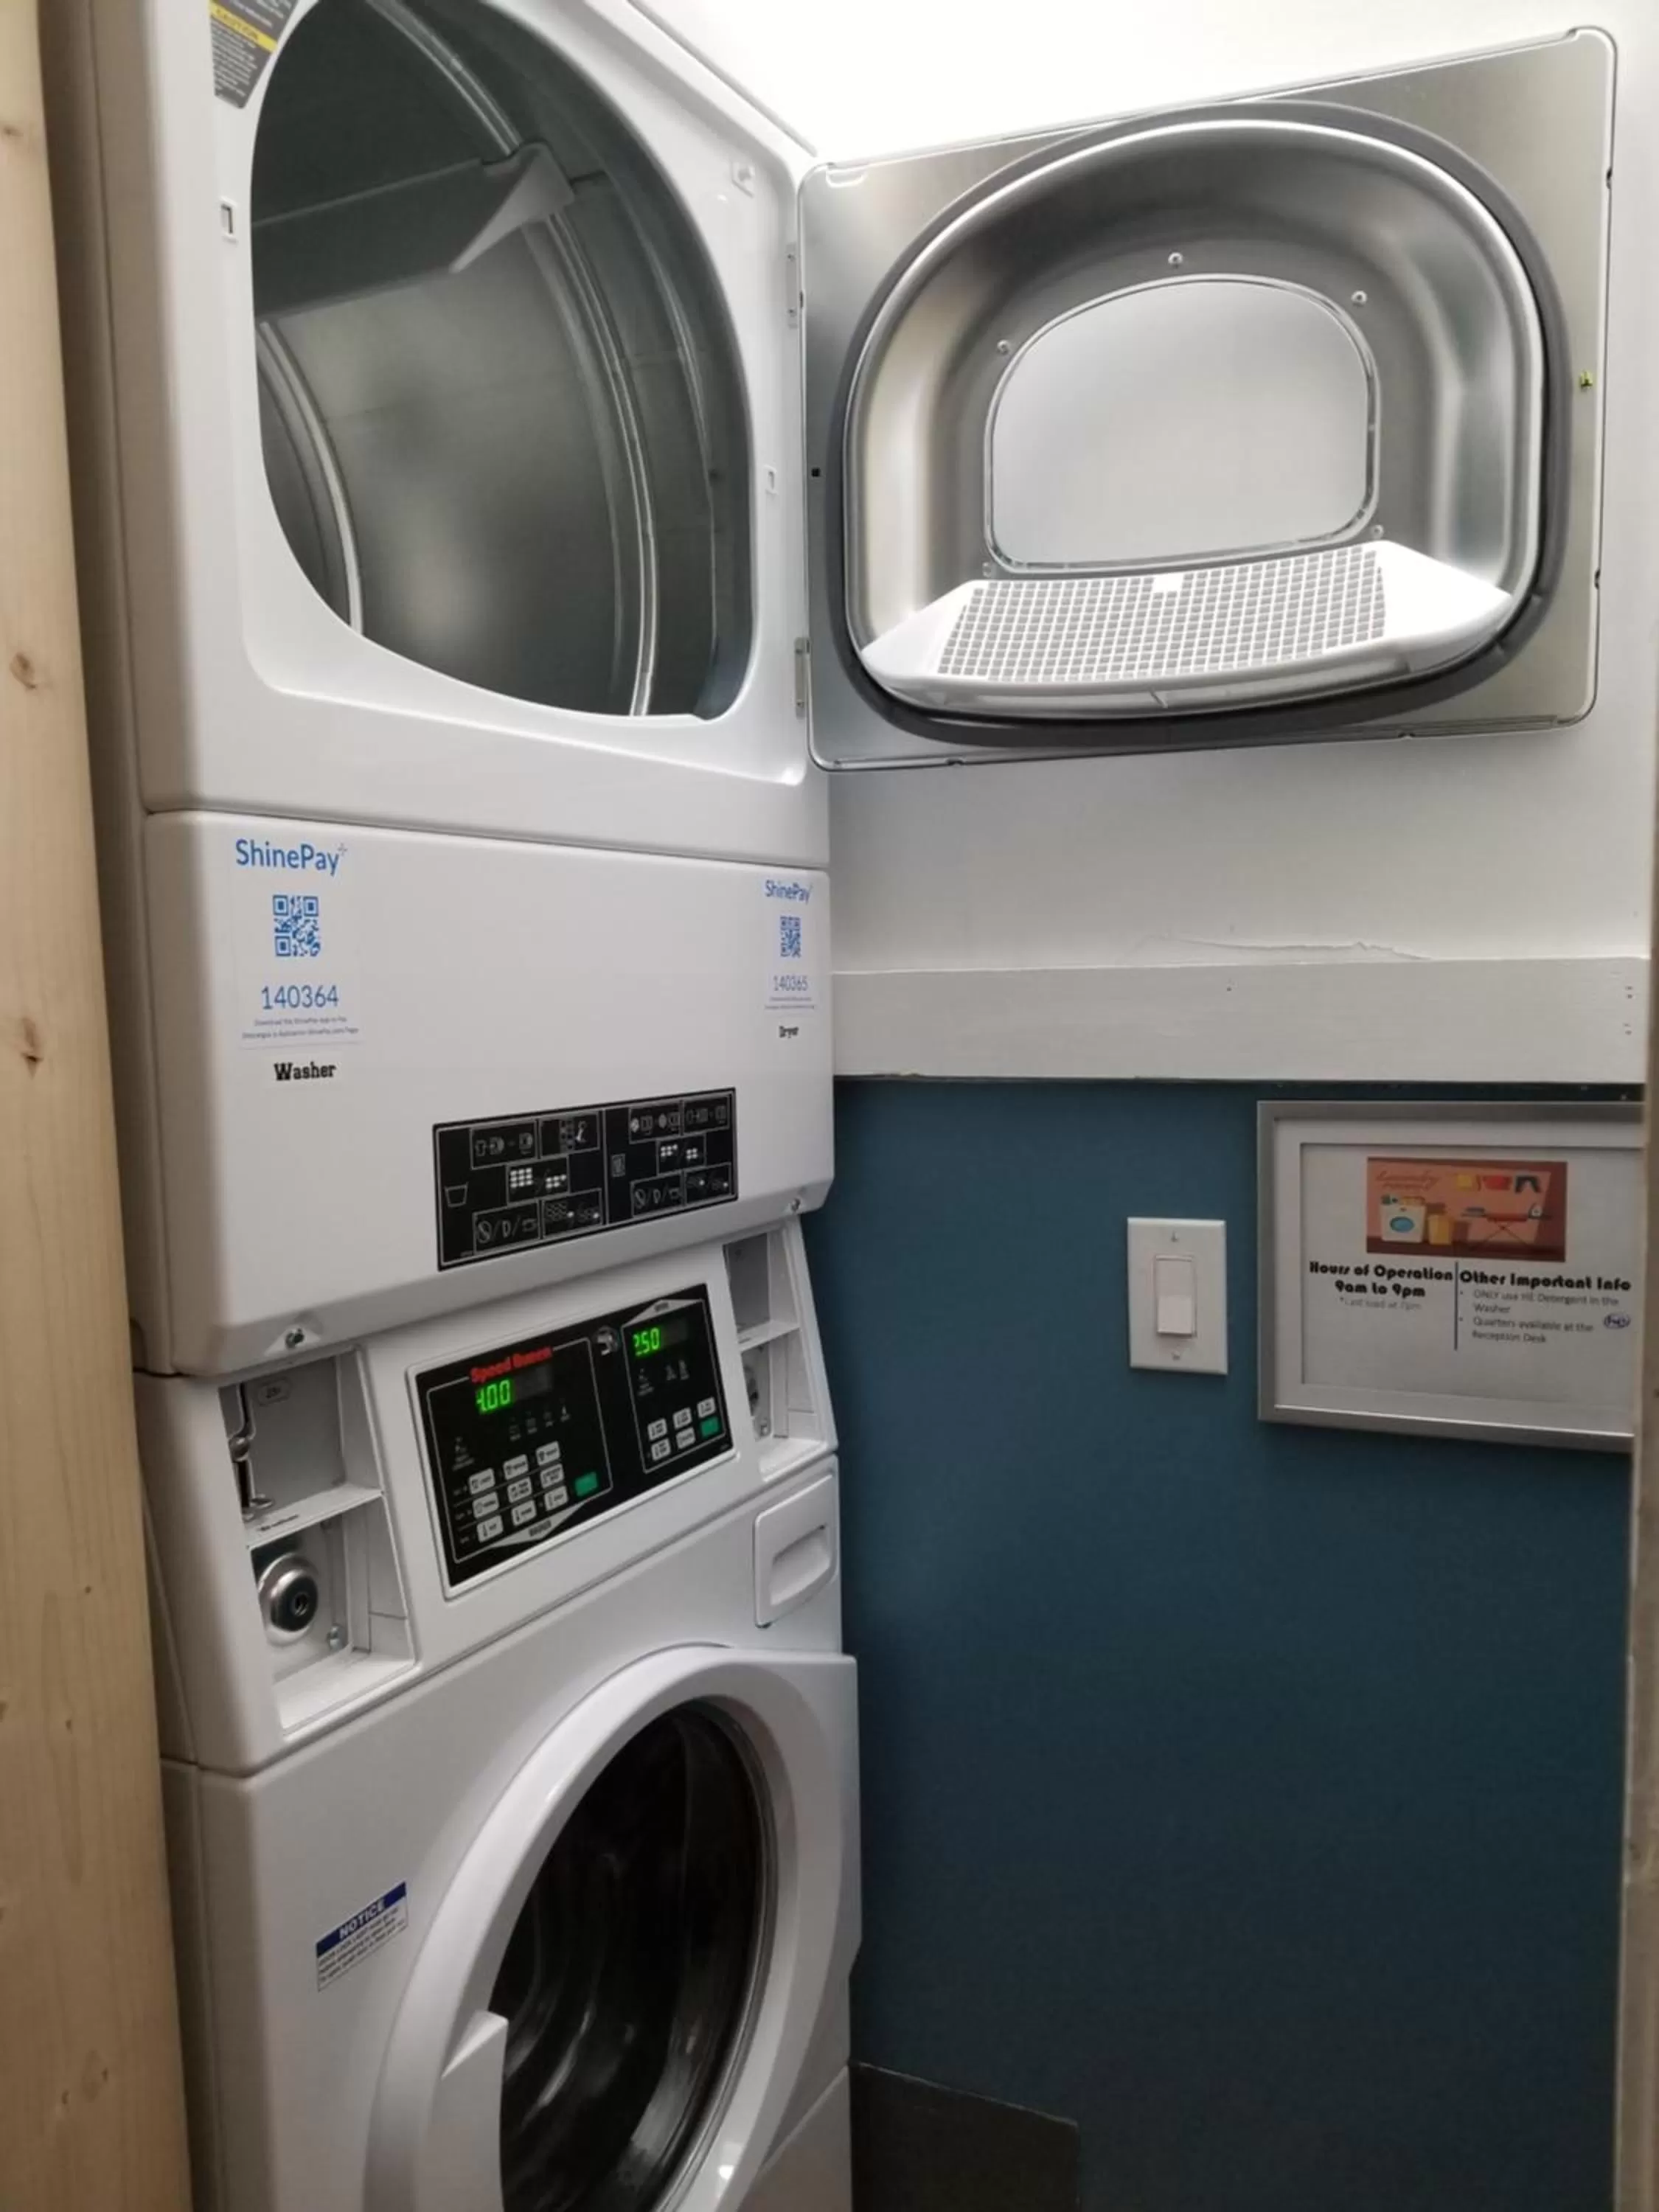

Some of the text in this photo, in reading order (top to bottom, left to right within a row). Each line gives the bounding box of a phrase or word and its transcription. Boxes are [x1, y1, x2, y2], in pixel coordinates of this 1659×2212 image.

[235, 839, 340, 877] ShinePay
[765, 879, 810, 905] ShinePay
[261, 985, 339, 1009] 140364
[274, 1060, 337, 1081] Washer
[1310, 1260, 1453, 1281] Hours of Operation
[1459, 1270, 1632, 1292] Other Important Info
[1335, 1279, 1426, 1299] 9am to 9pm
[1474, 1304, 1511, 1314] Washer
[1537, 1293, 1587, 1306] Detergent
[1601, 1297, 1619, 1307] the
[1473, 1317, 1515, 1329] Quarters
[1519, 1320, 1561, 1331] available
[1576, 1322, 1594, 1332] the
[1472, 1330, 1546, 1343] Reception Desk
[339, 1899, 386, 1938] NOTICE
